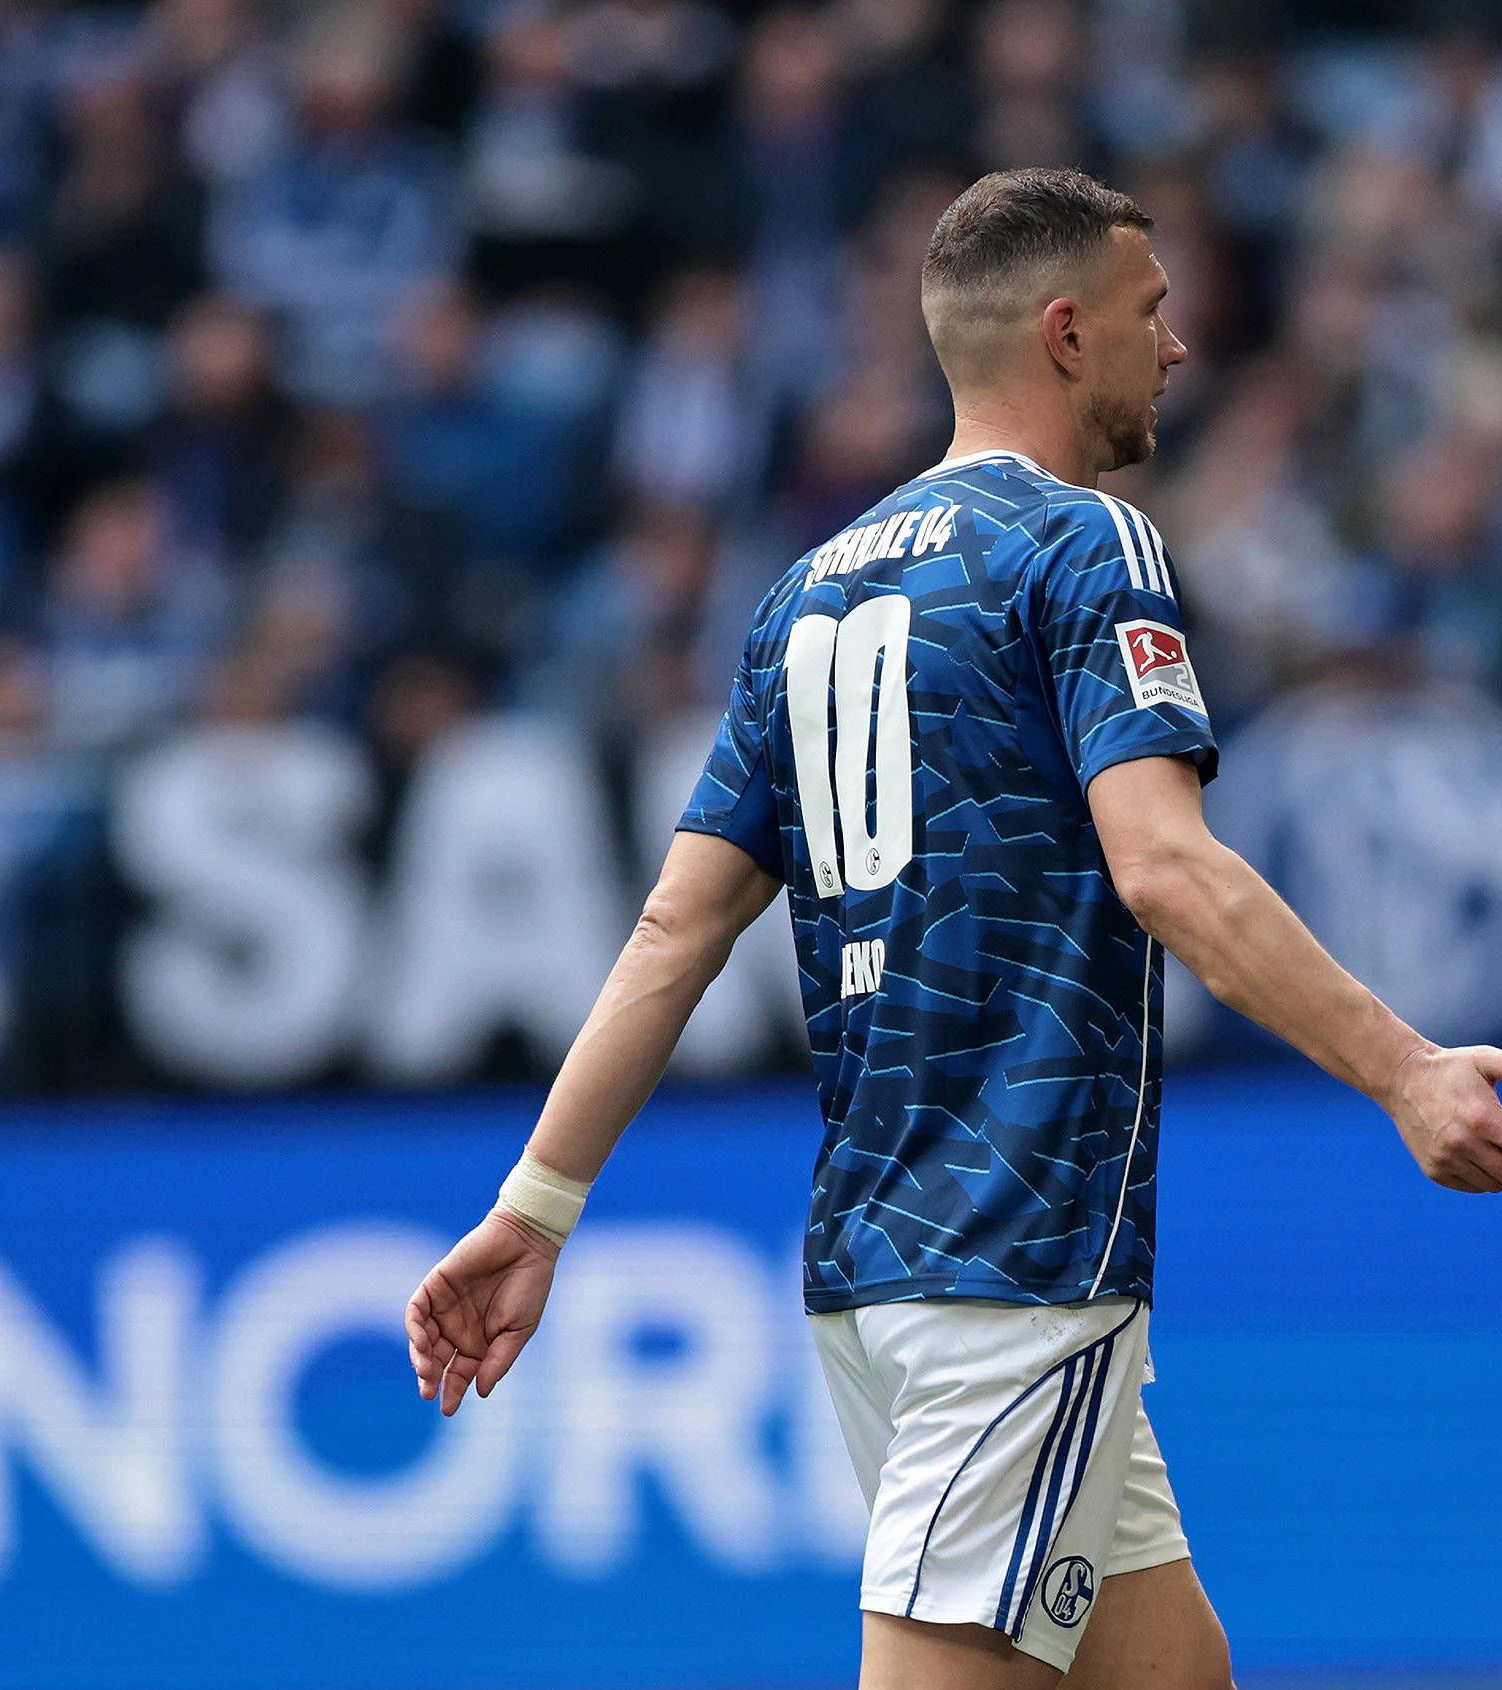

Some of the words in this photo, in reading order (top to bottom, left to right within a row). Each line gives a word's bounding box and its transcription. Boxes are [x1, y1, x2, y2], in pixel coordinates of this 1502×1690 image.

[912, 504, 963, 557] 04
[1141, 686, 1199, 708] BUNDESLIGA
[783, 594, 912, 898] 10
